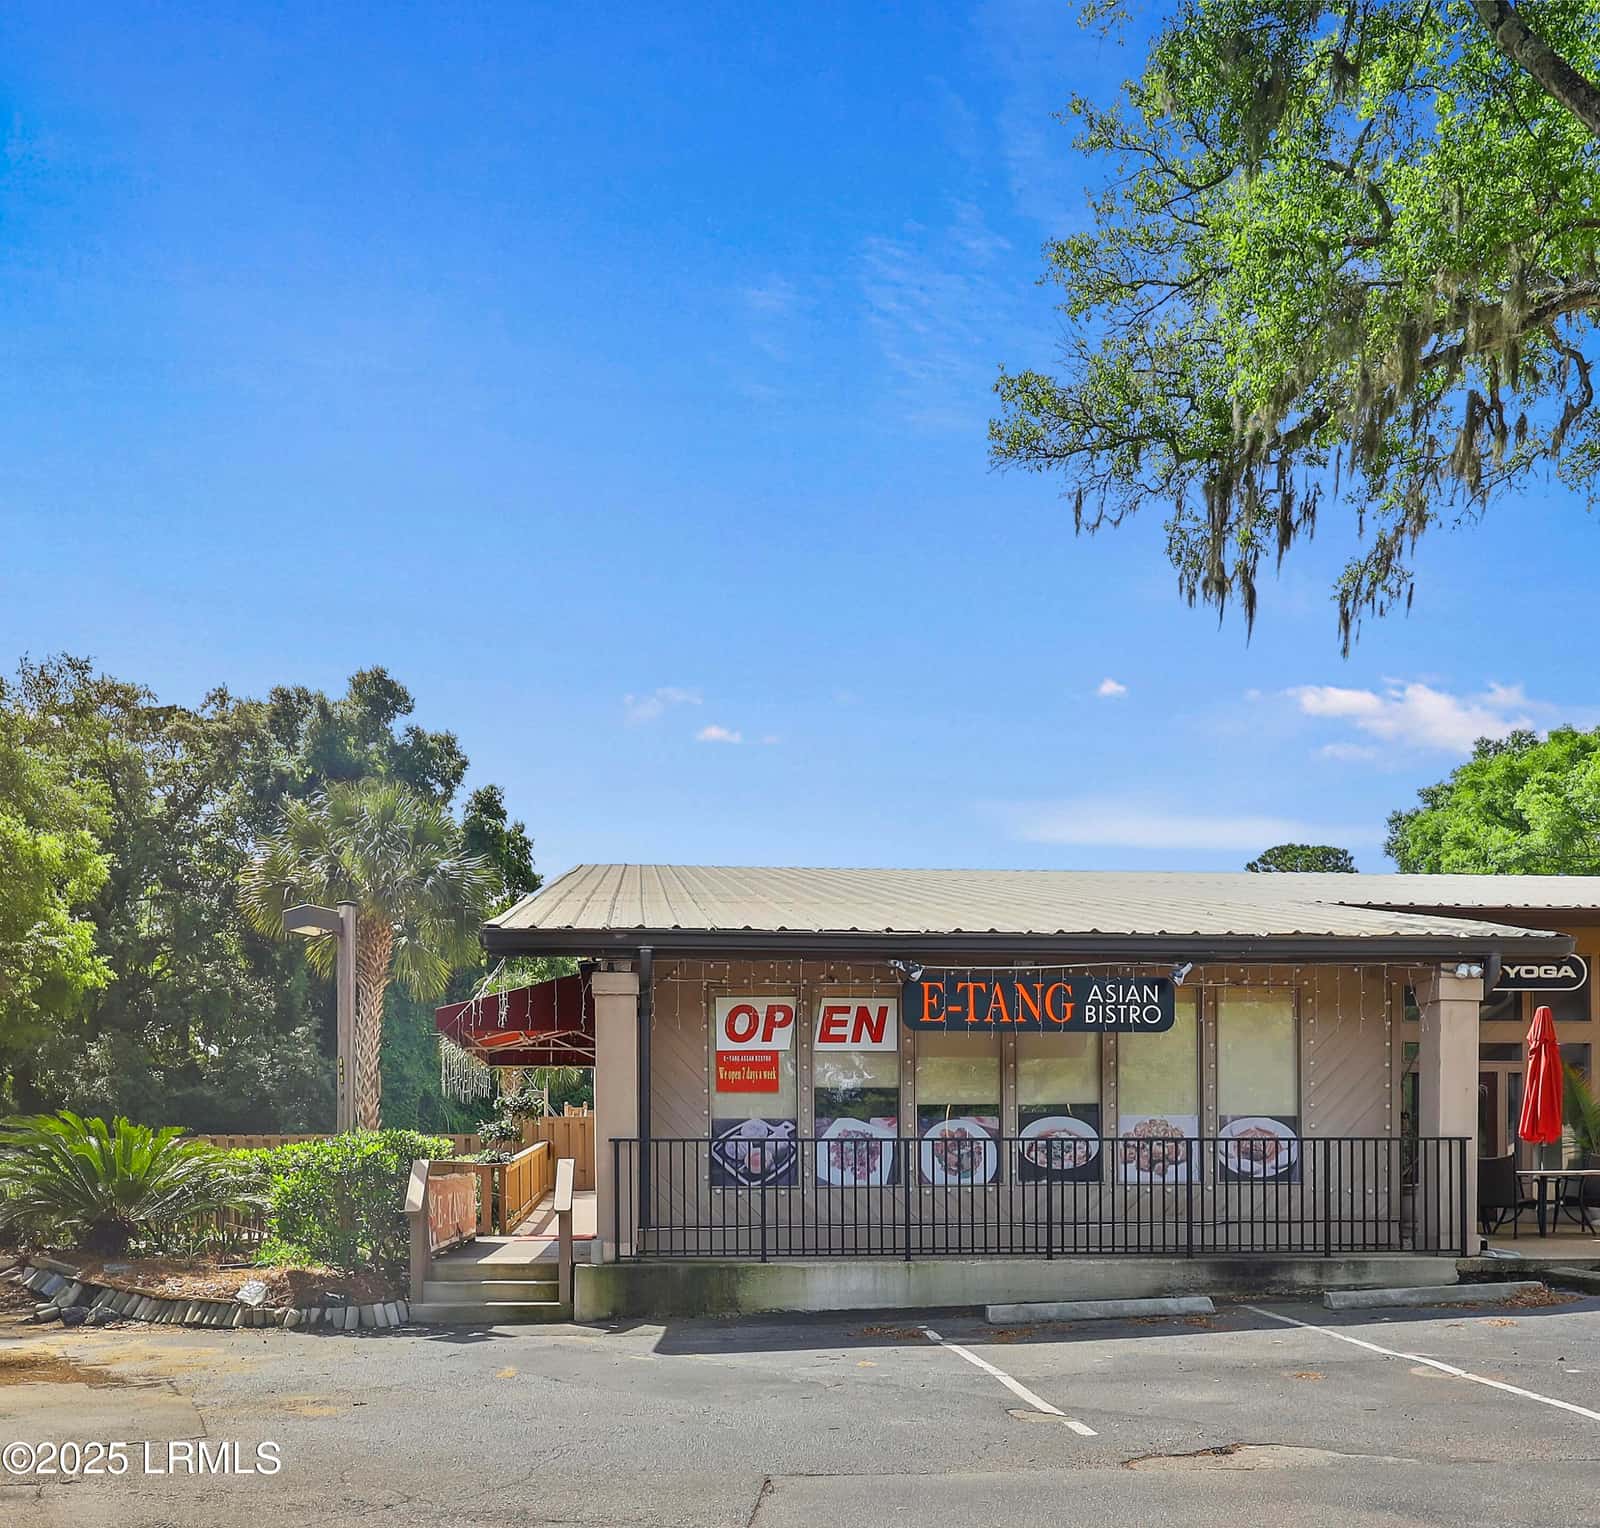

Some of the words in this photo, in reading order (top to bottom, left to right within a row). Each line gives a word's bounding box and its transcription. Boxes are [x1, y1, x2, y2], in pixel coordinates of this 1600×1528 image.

[1501, 965, 1577, 979] YOGA
[919, 982, 1076, 1024] E-TANG
[1087, 984, 1160, 1003] ASIAN
[1084, 1005, 1162, 1024] BISTRO
